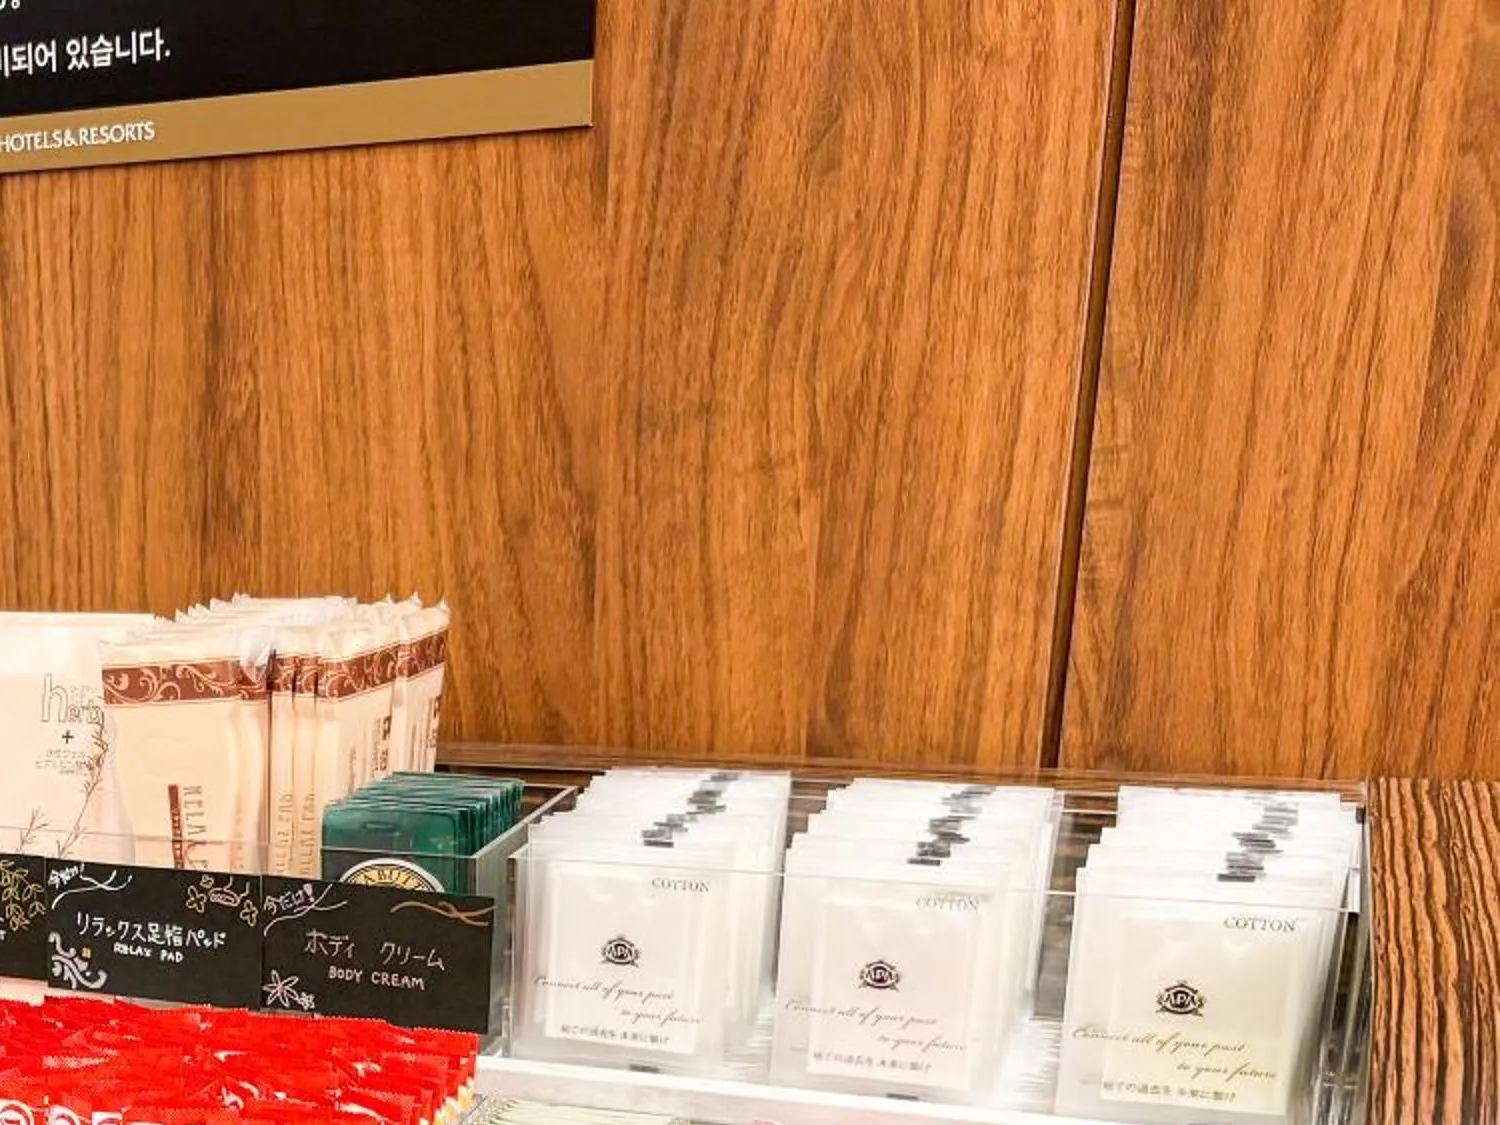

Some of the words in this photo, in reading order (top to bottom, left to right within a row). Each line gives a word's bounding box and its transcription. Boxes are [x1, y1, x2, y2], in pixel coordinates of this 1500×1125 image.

[65, 27, 171, 71] 있습니다.
[1223, 916, 1298, 933] COTTON
[160, 950, 184, 963] PAD
[380, 942, 445, 971] クリーム
[329, 966, 362, 983] BODY
[371, 971, 425, 991] CREAM
